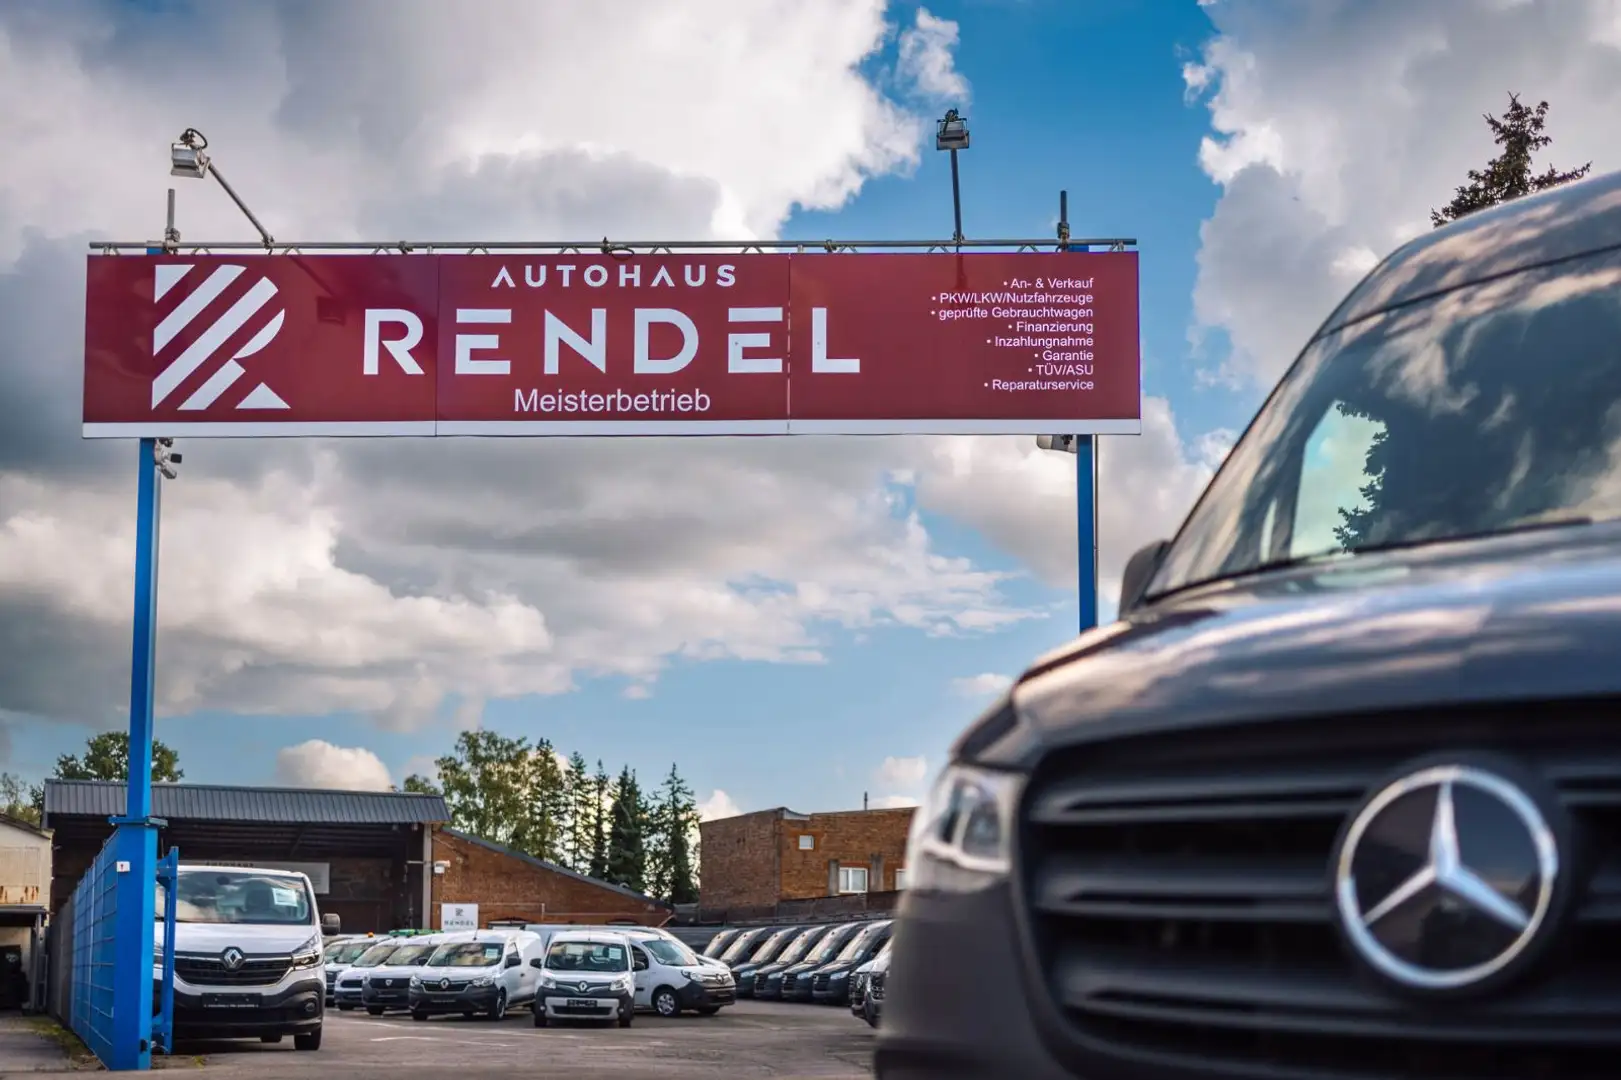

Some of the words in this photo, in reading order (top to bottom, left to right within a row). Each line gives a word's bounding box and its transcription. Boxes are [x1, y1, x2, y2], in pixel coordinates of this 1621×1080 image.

[491, 264, 736, 288] AUTOHAUS
[1010, 277, 1032, 289] An-
[1035, 277, 1044, 289] &
[1047, 277, 1094, 289] Verkauf
[939, 292, 1094, 305] PKW/LKW/Nutzfahrzeuge
[938, 306, 988, 320] geprüfte
[991, 306, 1094, 320] Gebrauchtwagen
[1016, 321, 1094, 334] Finanzierung
[362, 306, 861, 375] RENDEL
[995, 336, 1094, 349] Inzahlungnahme
[1042, 350, 1094, 361] Garantie
[1036, 363, 1094, 375] TÜV/ASU
[992, 379, 1094, 392] Reparaturservice
[514, 387, 711, 412] Meisterbetrieb
